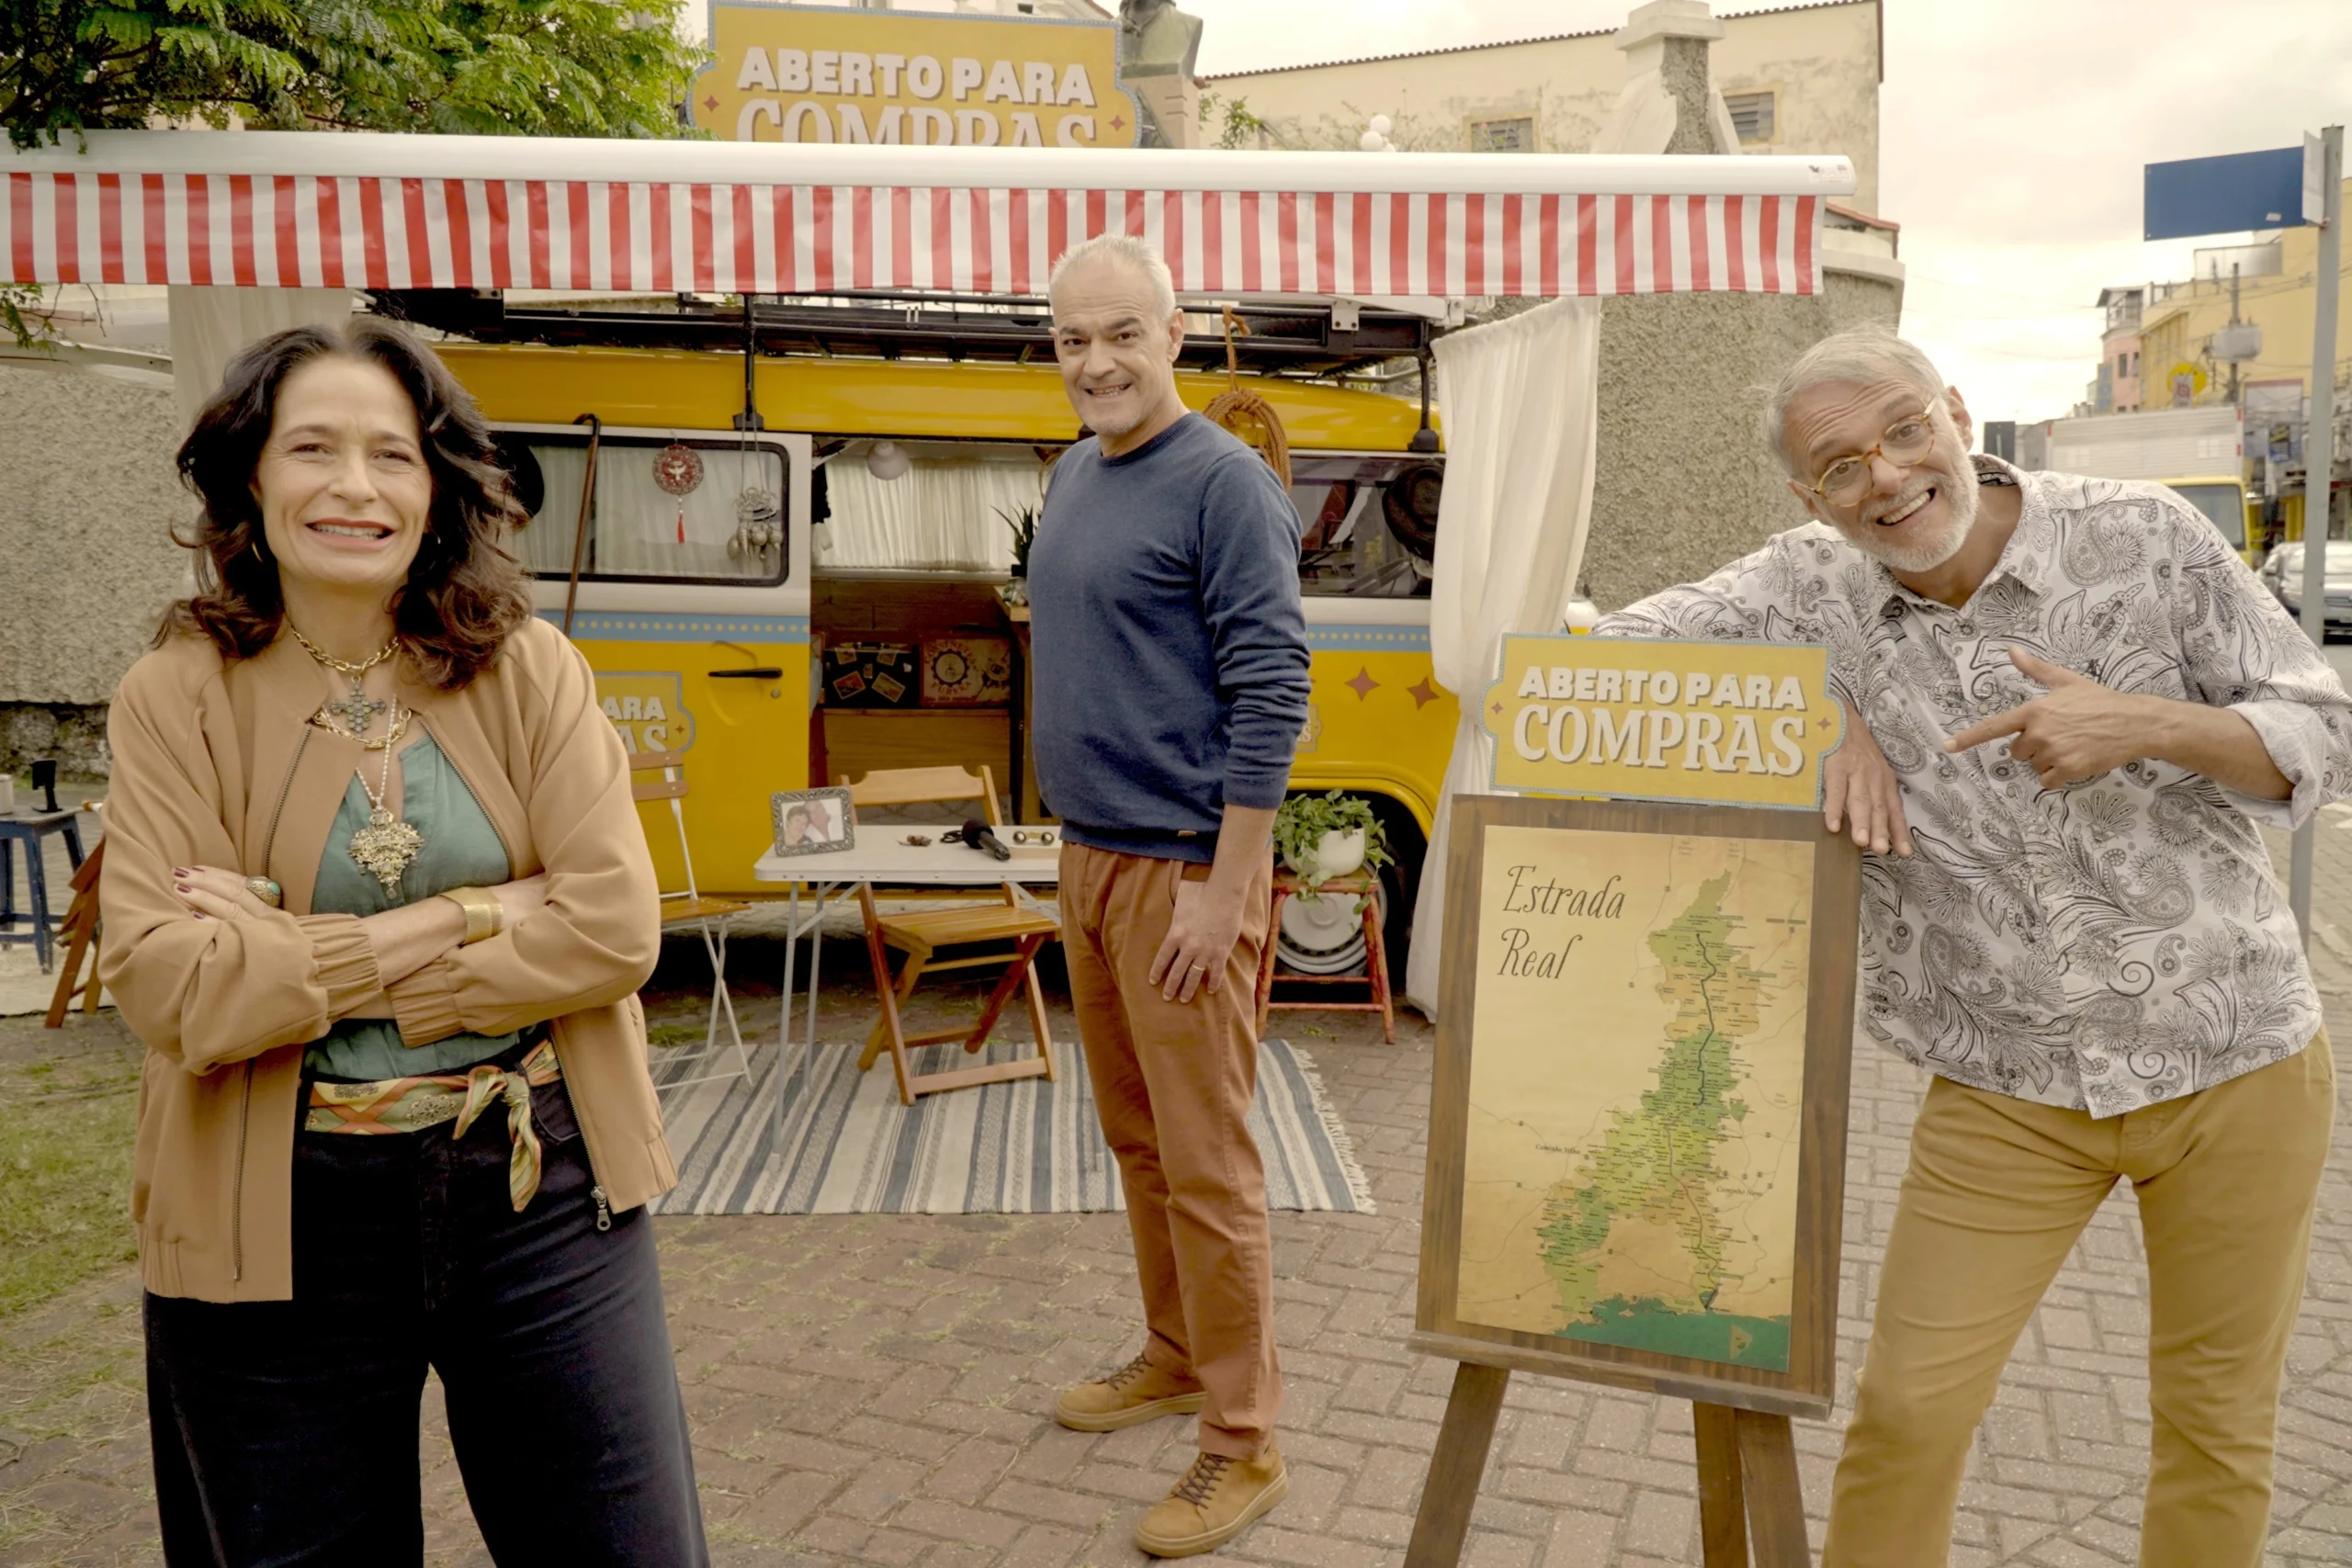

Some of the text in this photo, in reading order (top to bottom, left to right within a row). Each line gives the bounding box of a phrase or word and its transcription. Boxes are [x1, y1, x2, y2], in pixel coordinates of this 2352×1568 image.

[737, 46, 1096, 107] ABERTO PARA
[602, 696, 667, 721] ARA
[1518, 666, 1807, 711] ABERTO PARA
[1513, 705, 1805, 777] COMPRAS
[1503, 865, 1625, 919] Estrada
[1497, 928, 1582, 980] Real
